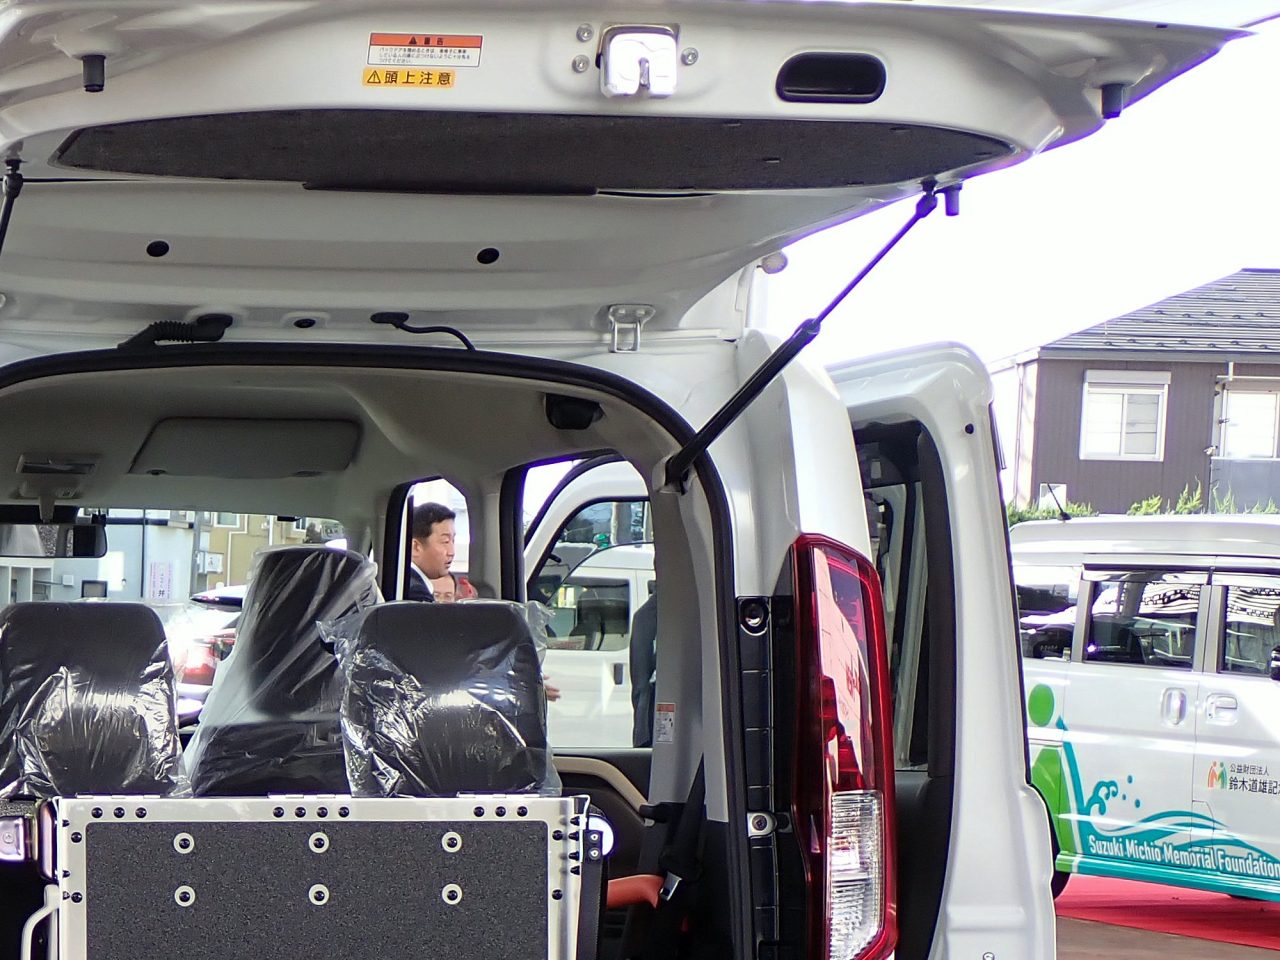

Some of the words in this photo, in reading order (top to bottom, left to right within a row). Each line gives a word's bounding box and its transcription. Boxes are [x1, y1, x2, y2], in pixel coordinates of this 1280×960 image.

[384, 70, 451, 86] 頭上注意
[1230, 763, 1269, 776] 公益財団法人
[1229, 776, 1280, 795] 鈴木道雄記
[1088, 834, 1123, 857] Suzuki
[1125, 838, 1161, 862] Michio
[1163, 843, 1216, 869] Memorial
[1218, 850, 1280, 877] Foundation
